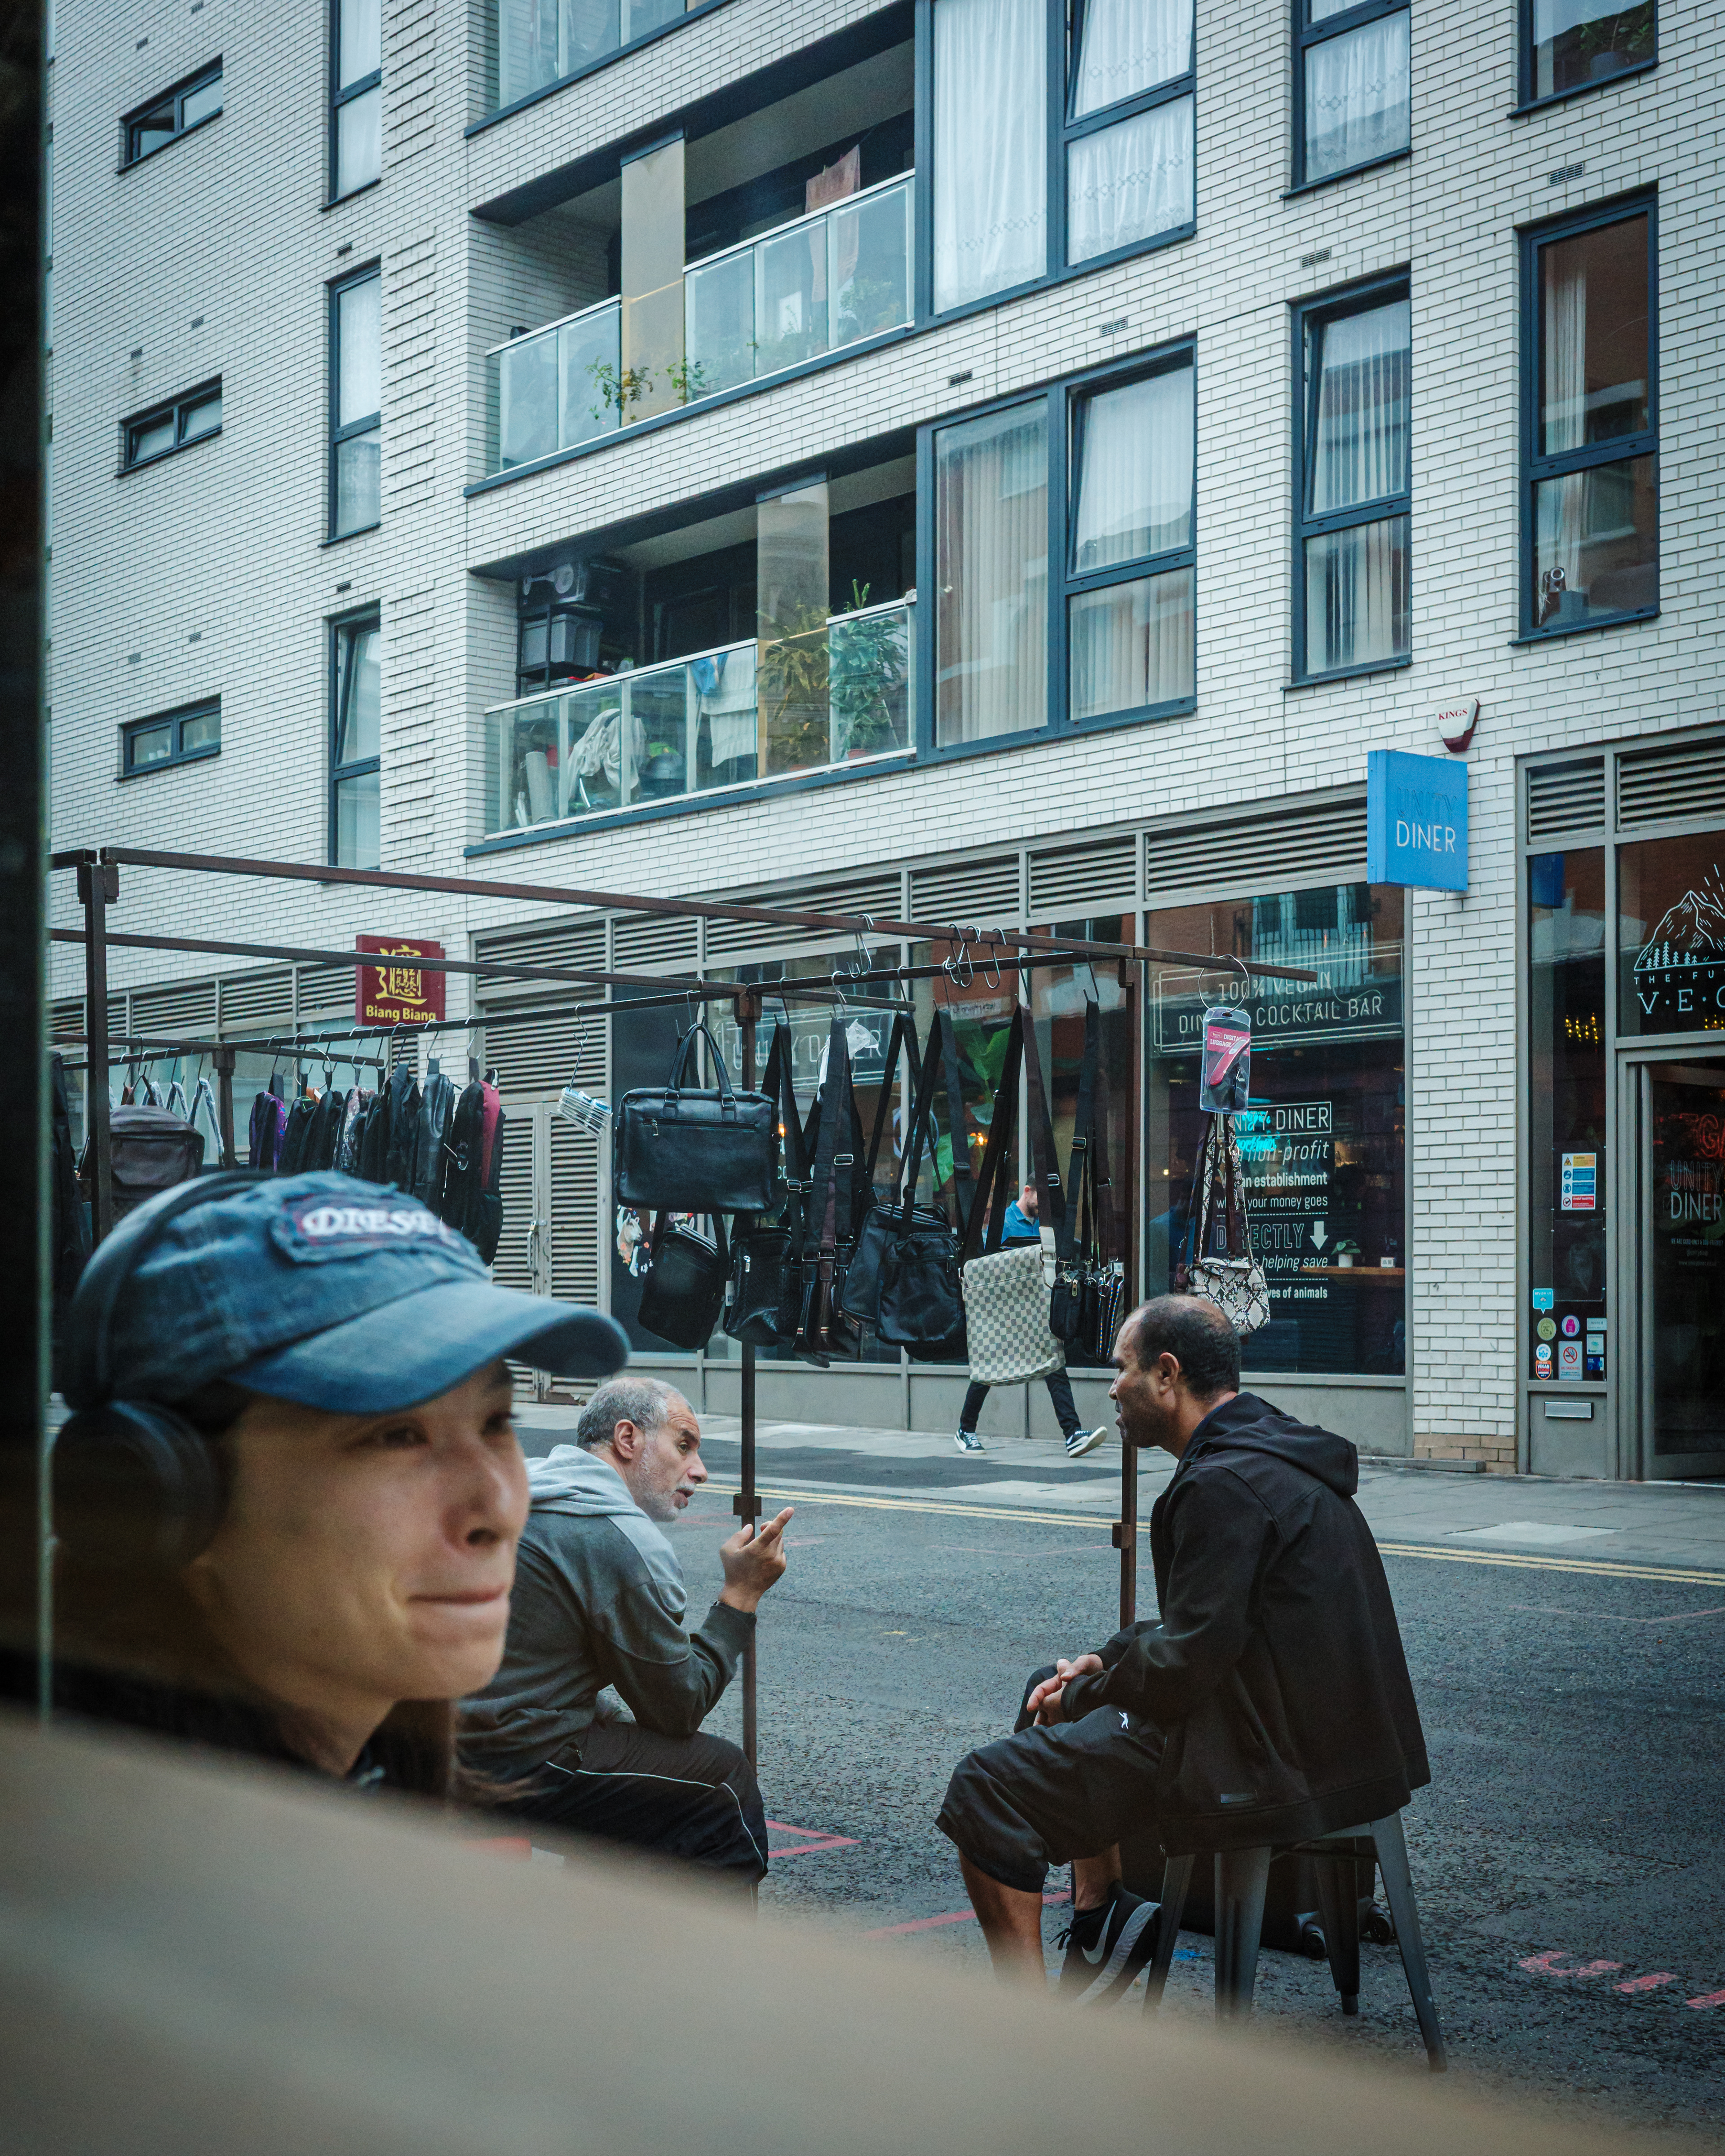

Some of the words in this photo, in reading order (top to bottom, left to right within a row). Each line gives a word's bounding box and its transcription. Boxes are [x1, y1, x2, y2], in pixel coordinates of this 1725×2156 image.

[1438, 708, 1467, 720] KINGS
[1397, 819, 1456, 853] DINER
[1634, 974, 1670, 985] THE
[1219, 978, 1265, 1001] 100%
[366, 1005, 400, 1022] Biang
[402, 1007, 436, 1021] Biang
[1179, 1013, 1205, 1033] DIN
[1256, 1001, 1340, 1026] COCKTAIL
[1348, 995, 1382, 1018] BAR
[1210, 1039, 1232, 1047] LUGGAGE
[1276, 1107, 1329, 1130] DINER
[1254, 1171, 1328, 1188] establishment
[1671, 1160, 1724, 1193] UNITY
[1247, 1198, 1268, 1211] your
[1270, 1197, 1302, 1210] money
[1305, 1196, 1328, 1210] goes
[1671, 1192, 1723, 1220] DINER
[1216, 1223, 1305, 1250] DECTLY
[1261, 1254, 1300, 1272] helping
[1302, 1257, 1328, 1268] save
[1267, 1288, 1281, 1299] ves
[1283, 1286, 1292, 1299] of
[1294, 1286, 1328, 1299] animals
